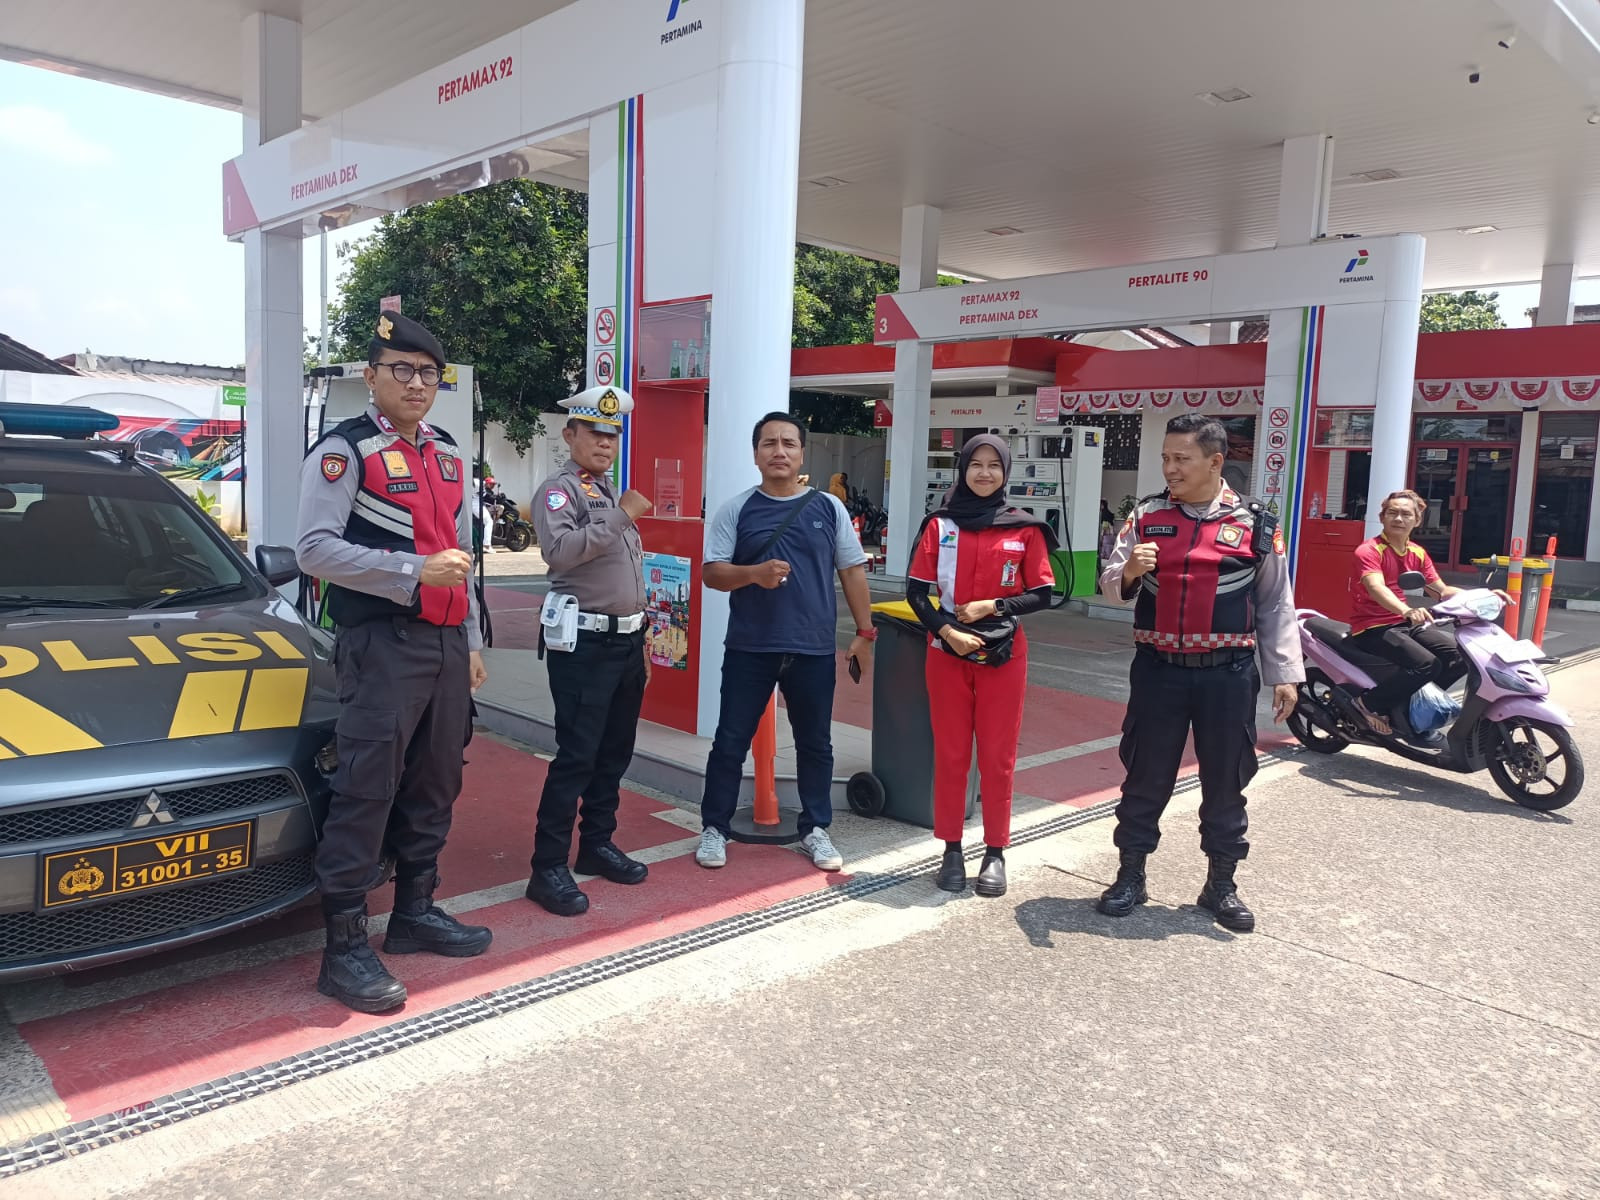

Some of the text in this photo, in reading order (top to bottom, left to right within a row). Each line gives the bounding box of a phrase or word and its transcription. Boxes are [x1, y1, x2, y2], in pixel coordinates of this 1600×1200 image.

[660, 19, 703, 45] PERTAMINA
[438, 56, 513, 104] PERTAMAX 92
[291, 163, 359, 201] PERTAMINA DEX
[1128, 269, 1208, 288] PERTALITE 90
[1339, 275, 1374, 284] PERTAMINA
[960, 290, 1020, 306] PERTAMAX 92
[879, 317, 888, 334] 3
[959, 309, 1039, 325] PERTAMINA DEX
[876, 413, 883, 422] 5
[155, 833, 209, 857] VII
[120, 859, 192, 888] 31001
[215, 850, 243, 869] 35
